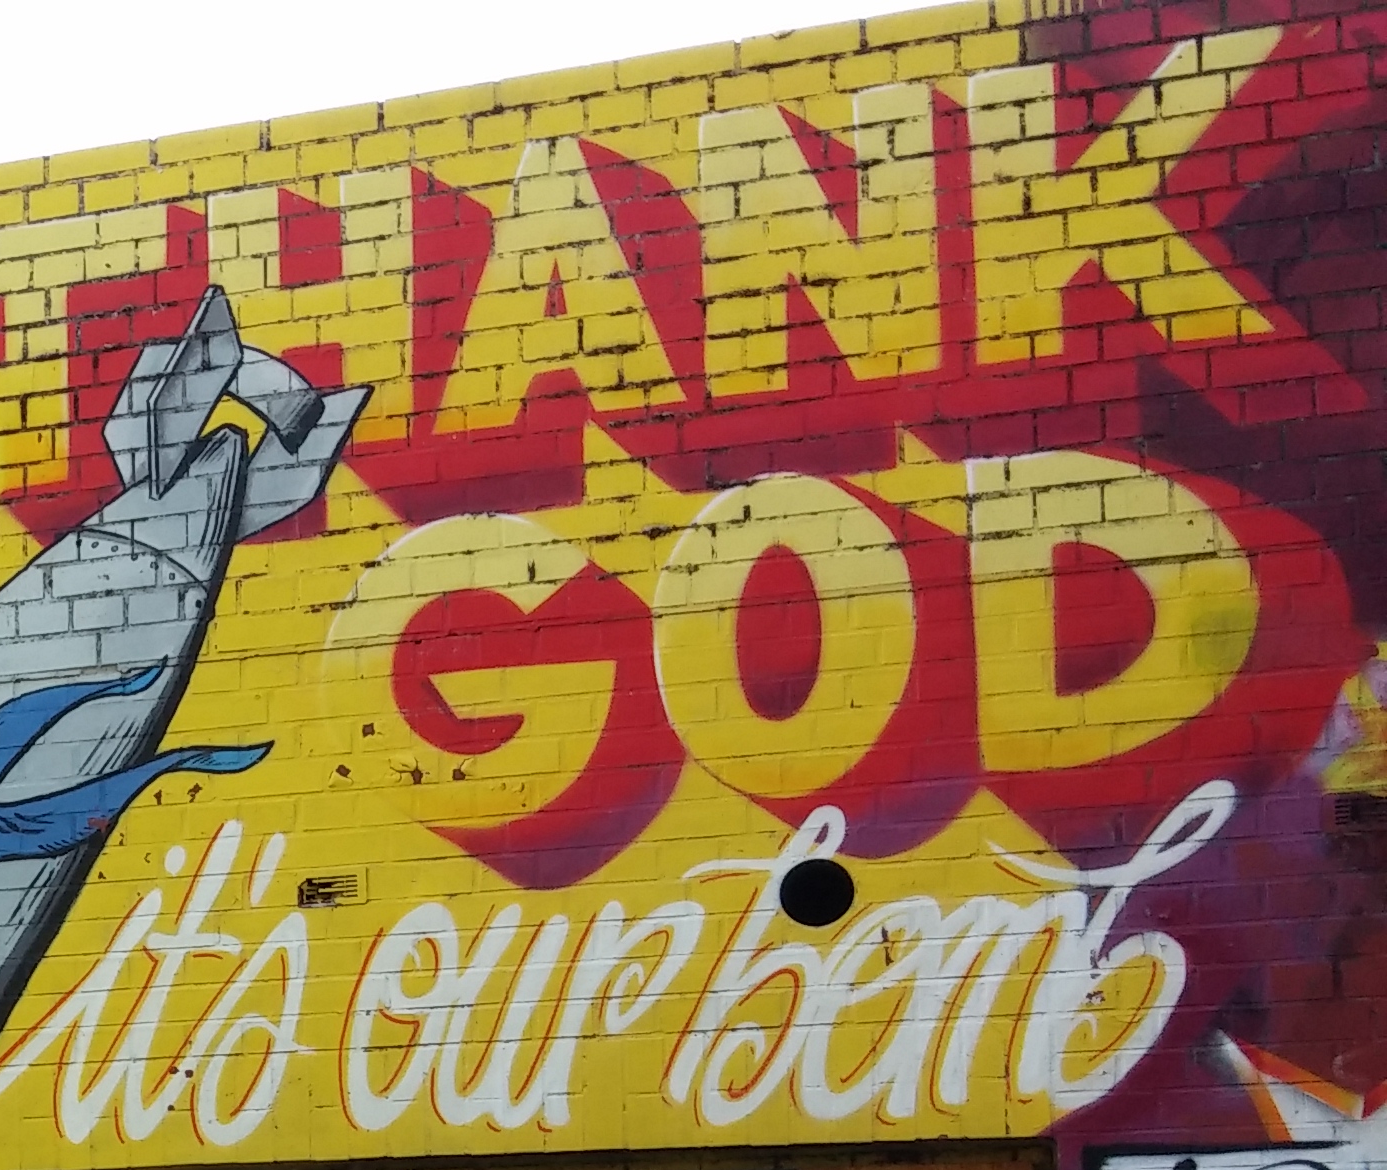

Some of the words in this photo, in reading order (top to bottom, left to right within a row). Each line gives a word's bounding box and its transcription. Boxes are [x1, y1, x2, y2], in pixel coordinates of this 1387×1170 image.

[323, 450, 1261, 828] GOD
[343, 900, 706, 1131] our
[665, 779, 1239, 1126] bomb
